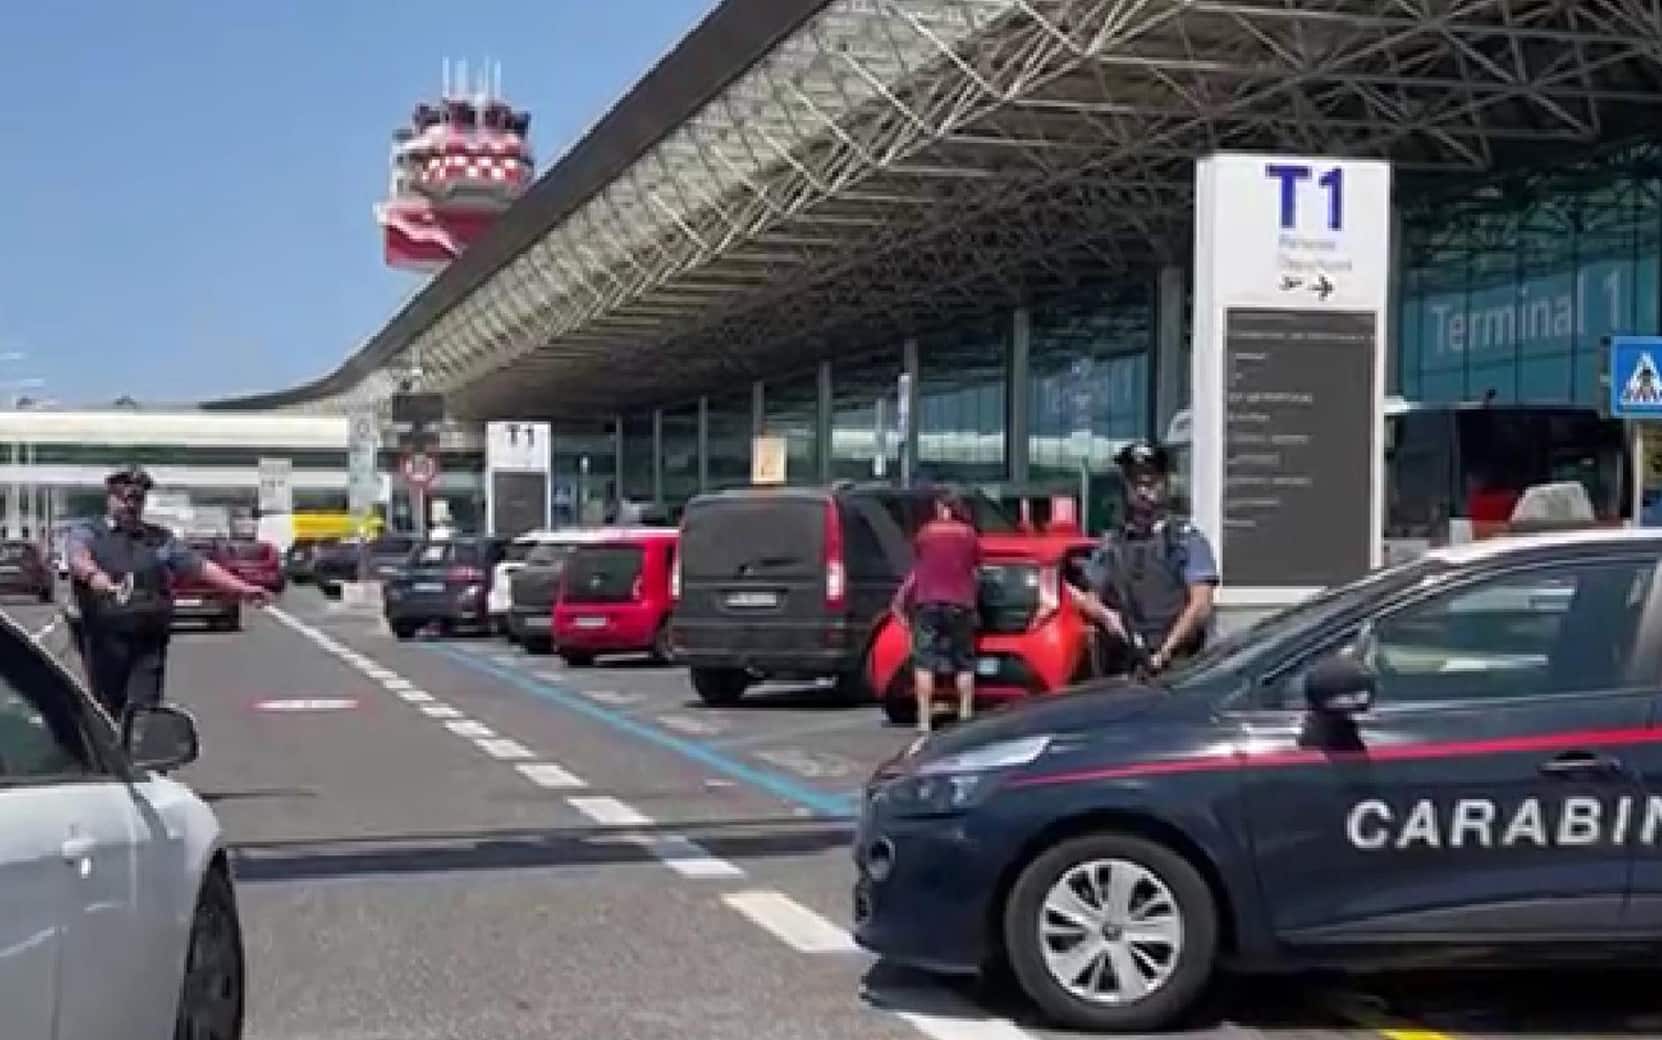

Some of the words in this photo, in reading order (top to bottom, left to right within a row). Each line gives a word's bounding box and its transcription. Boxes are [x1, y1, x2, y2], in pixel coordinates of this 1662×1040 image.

[1265, 165, 1343, 230] T1
[1431, 269, 1586, 353] Terminal
[1604, 269, 1621, 329] 1
[505, 424, 535, 448] T1
